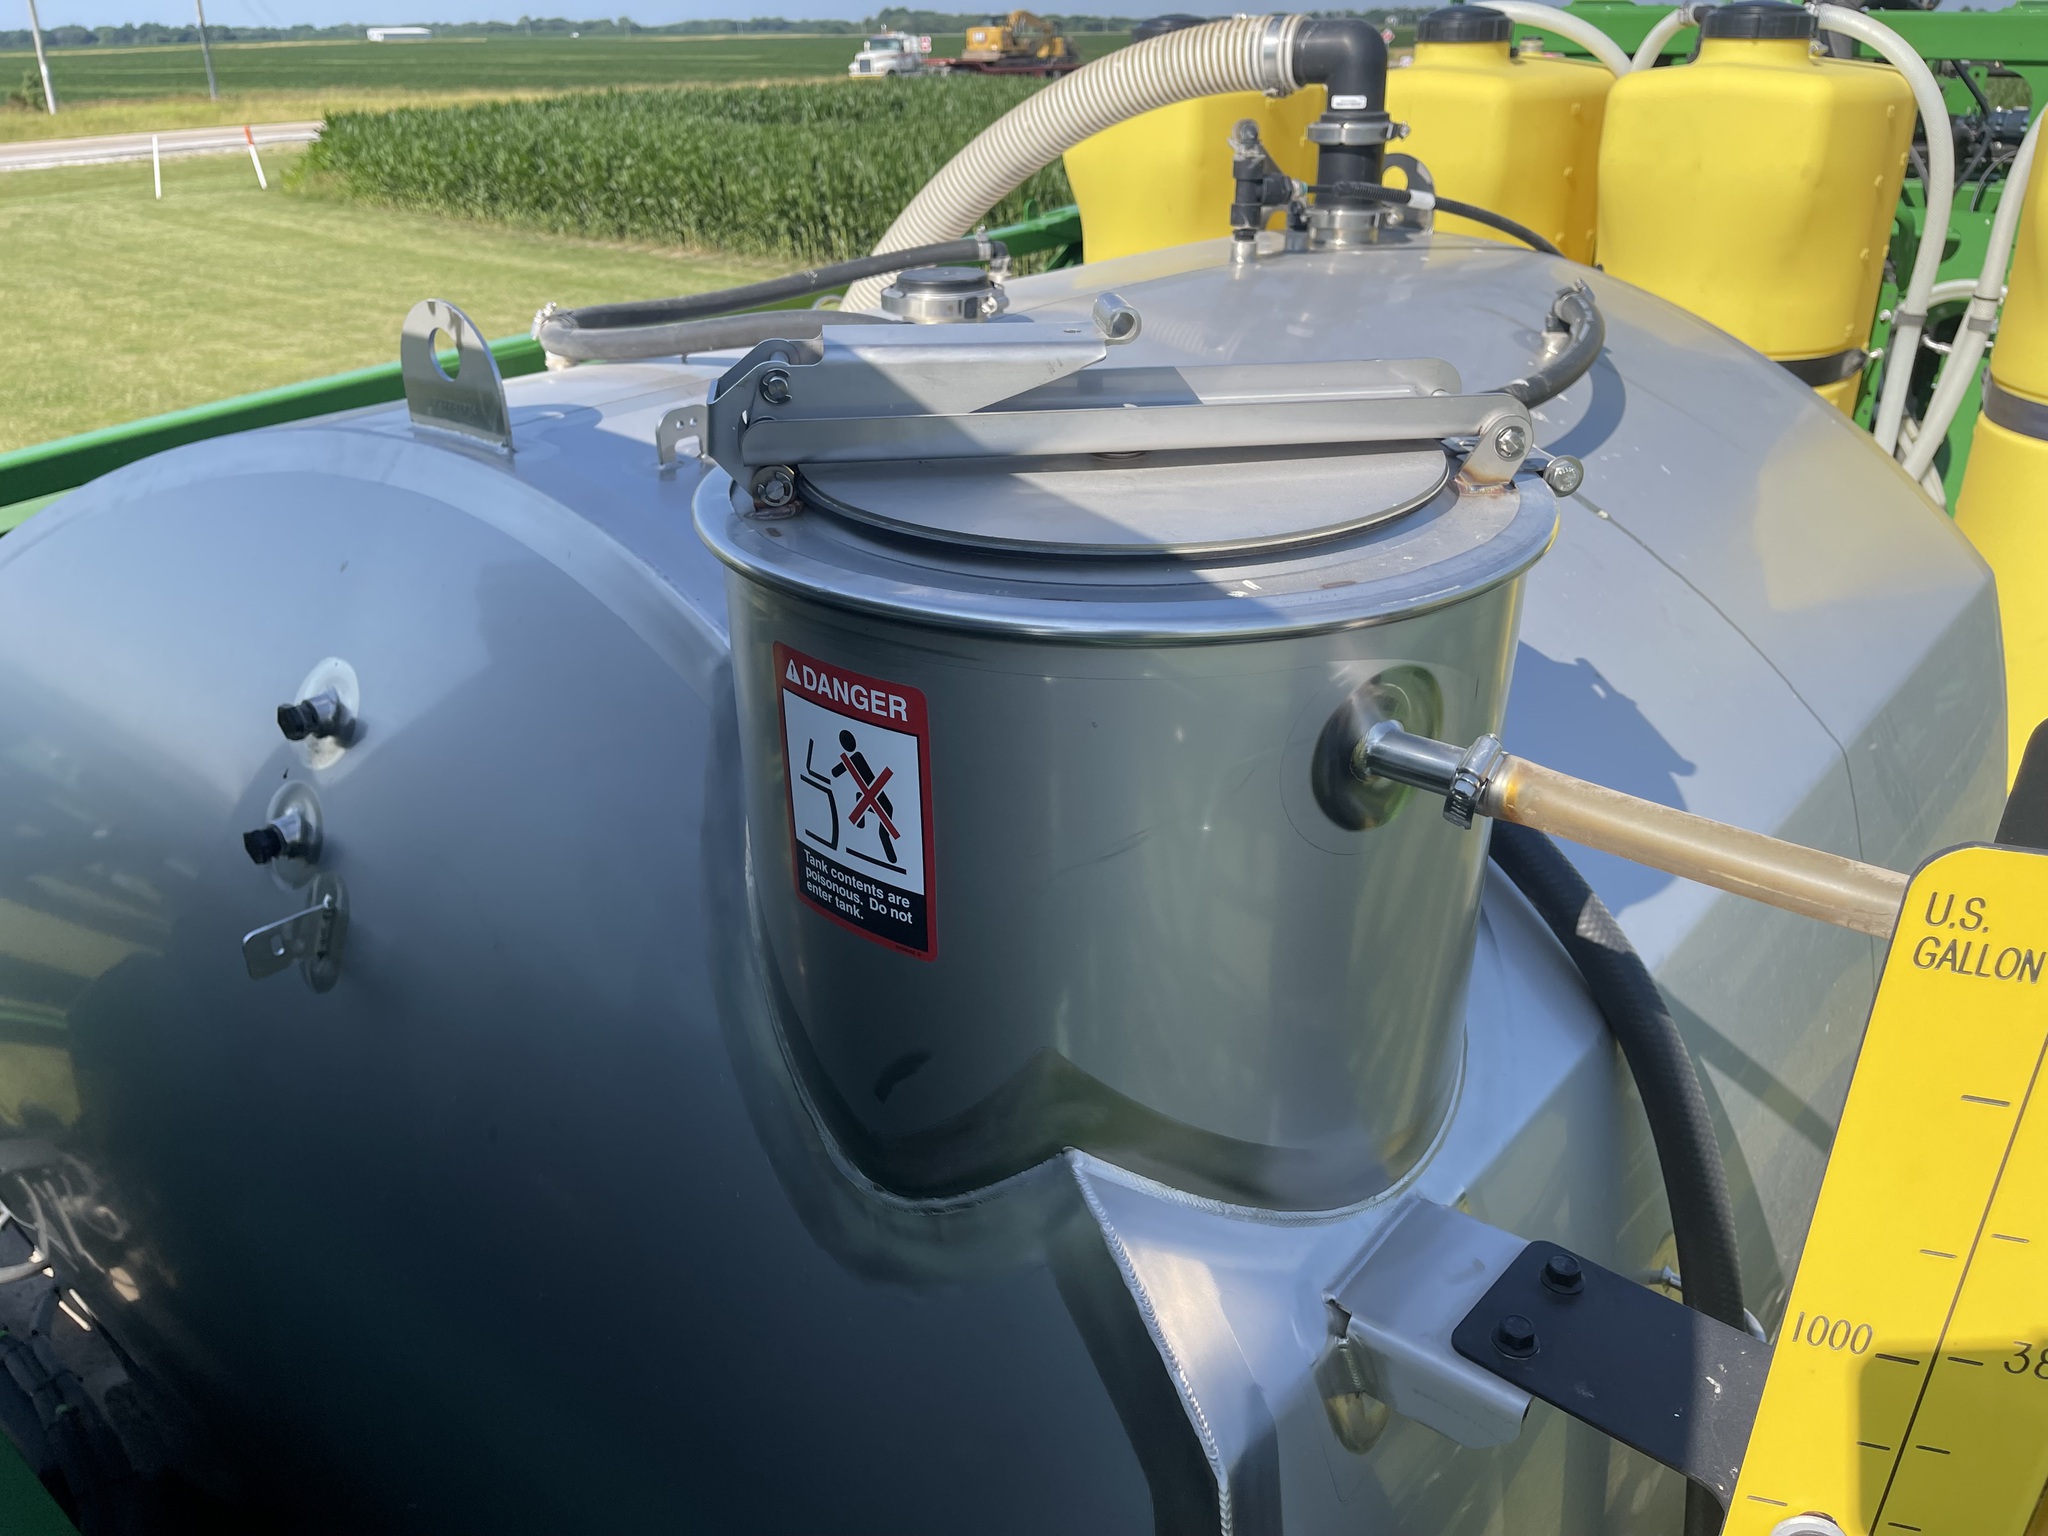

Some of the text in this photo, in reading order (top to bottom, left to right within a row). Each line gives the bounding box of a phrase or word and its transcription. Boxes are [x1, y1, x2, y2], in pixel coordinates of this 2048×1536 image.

[802, 664, 908, 722] DANGER
[804, 849, 911, 908] Tank contents are
[805, 866, 913, 925] poisonous. Do not
[806, 881, 864, 920] enter tank.
[1925, 891, 1990, 934] U.S.
[1913, 936, 2047, 984] GALLON
[1791, 1311, 1874, 1355] 1000
